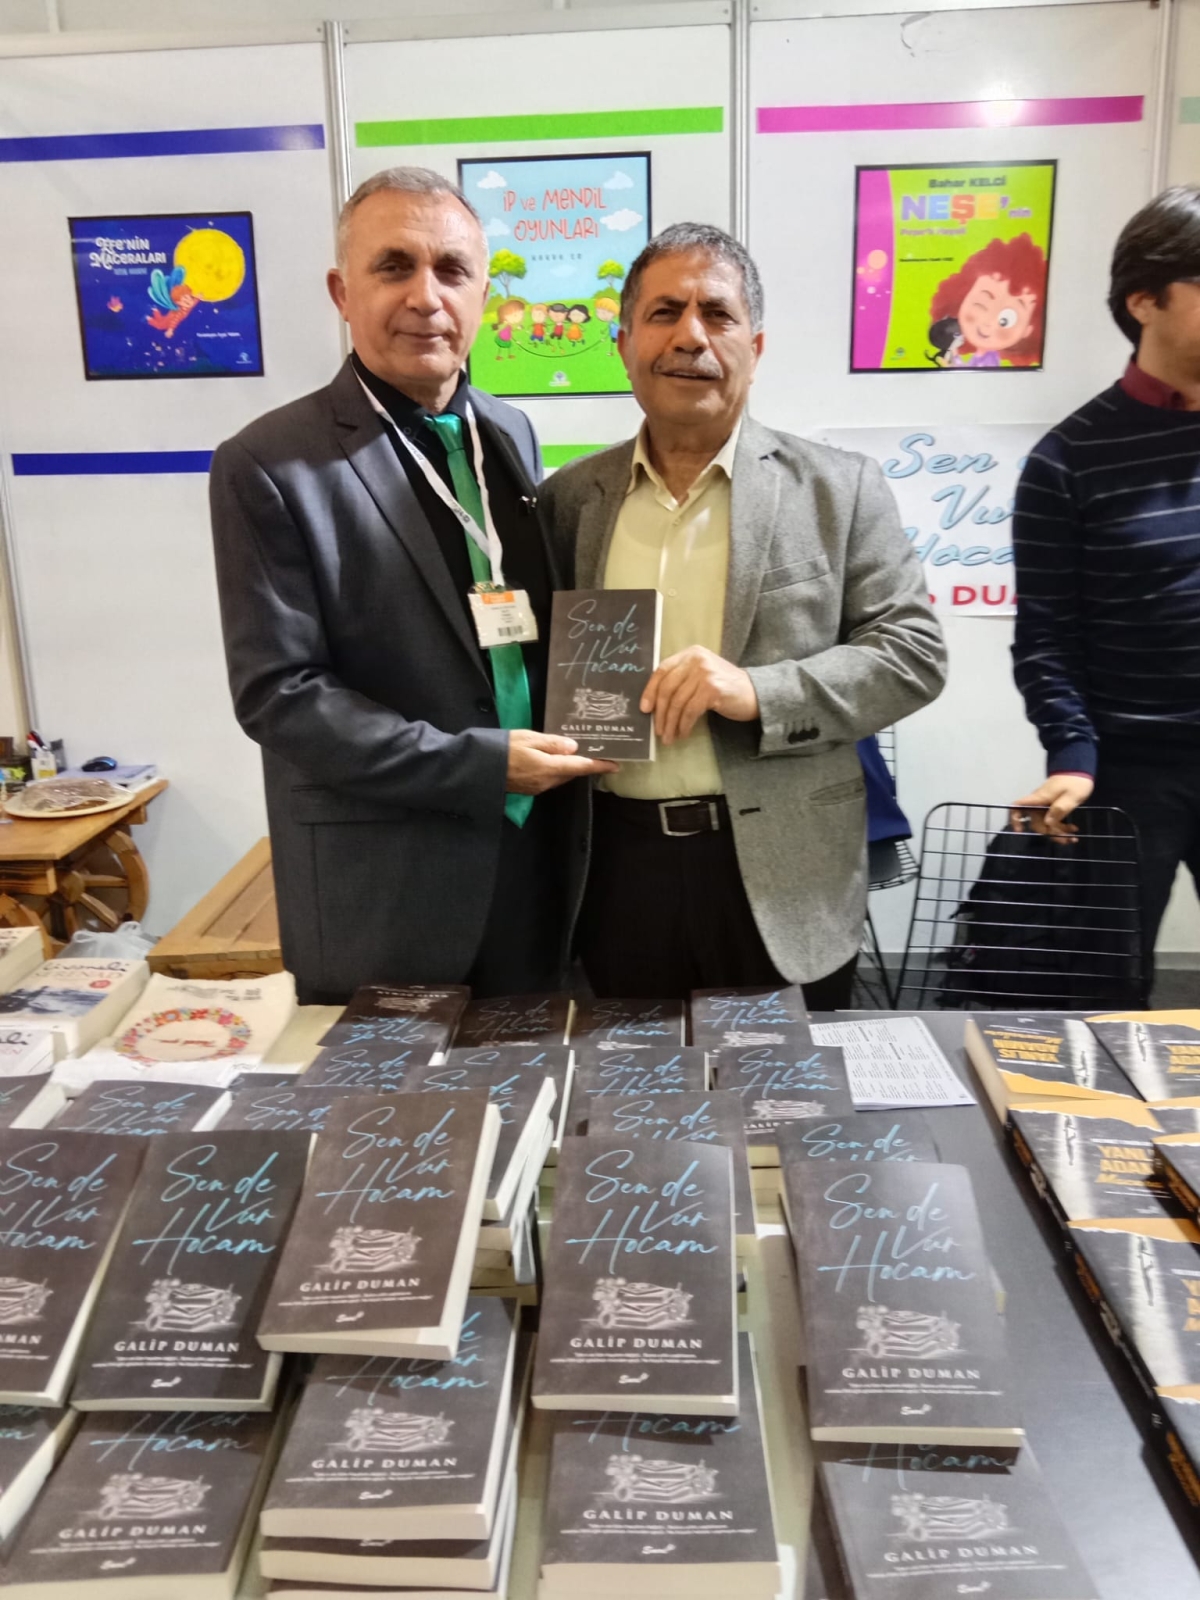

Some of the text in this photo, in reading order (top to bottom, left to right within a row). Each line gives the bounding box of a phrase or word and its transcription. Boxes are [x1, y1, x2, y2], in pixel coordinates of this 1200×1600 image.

[513, 217, 599, 241] OYUNLARI
[882, 433, 998, 479] Sen
[931, 484, 1014, 530] Vu
[567, 599, 639, 639] Sen de
[557, 639, 646, 686] Hocam
[561, 723, 593, 732] GALİP
[707, 991, 782, 1010] Sen de
[701, 1010, 798, 1030] Hocam
[325, 1049, 412, 1072] Sen de
[599, 1054, 684, 1077] Sen de
[738, 1049, 826, 1073] Sen de
[729, 1070, 840, 1099] Hocam
[90, 1086, 196, 1112] Sen de
[244, 1093, 300, 1120] Sen
[613, 1100, 716, 1132] Sen de
[342, 1107, 455, 1158] Sen de
[802, 1123, 911, 1157] Sen de
[0, 1142, 118, 1202] Sen de
[160, 1144, 279, 1203] Sen de
[585, 1149, 704, 1206] Sen de
[315, 1158, 456, 1224] Hocam
[824, 1173, 949, 1231] Sen de
[132, 1202, 278, 1275] Hocam
[565, 1205, 719, 1274] Hocam
[817, 1230, 977, 1303] Hocam
[300, 1278, 421, 1292] GALİP DUMAN
[114, 1339, 240, 1352] GALİP DUMAN
[570, 1337, 703, 1349] GALİP DUMAN
[842, 1367, 981, 1380] GALİP DUMAN
[311, 1457, 458, 1469] GALİP DUMAN
[583, 1508, 734, 1521] GALİP DUMAN
[58, 1524, 208, 1539] GALİP DUMAN
[884, 1545, 1039, 1563] GALİP DUMAN
